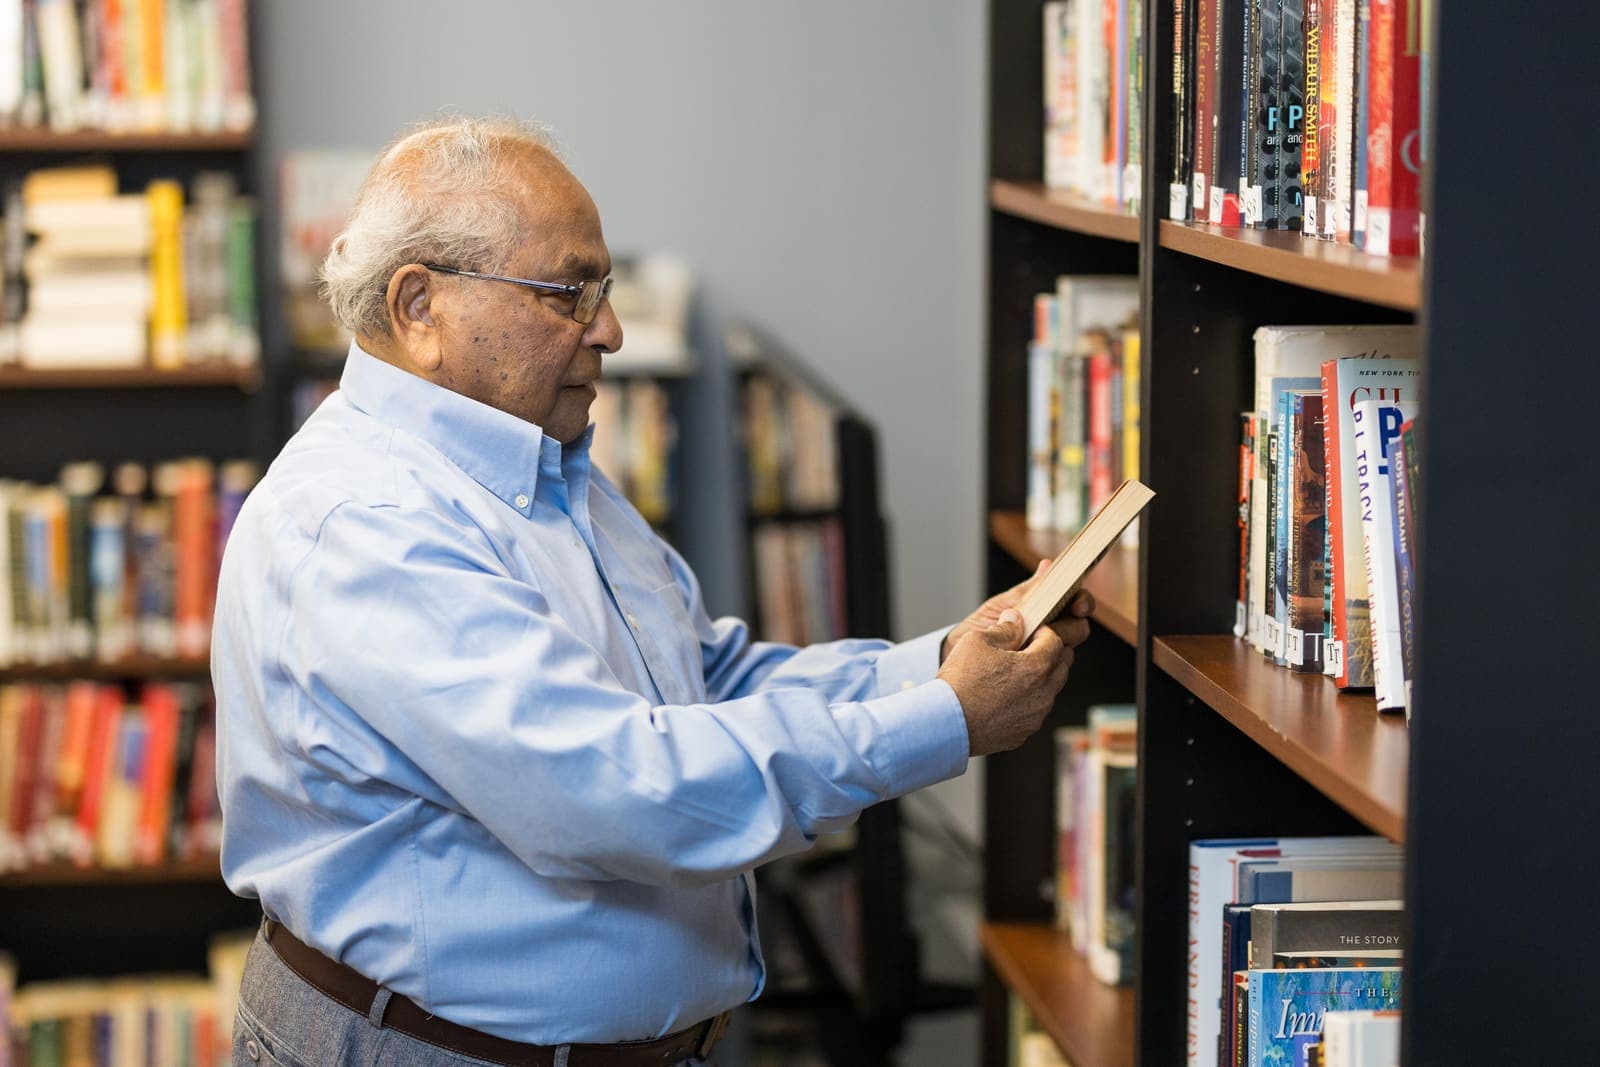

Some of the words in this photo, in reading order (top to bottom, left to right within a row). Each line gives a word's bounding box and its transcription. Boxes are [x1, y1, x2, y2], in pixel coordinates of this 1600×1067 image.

[1306, 26, 1319, 104] WILBUR
[1305, 104, 1318, 161] SMITH
[1277, 413, 1286, 482] SHOOTING
[1356, 450, 1372, 522] TRACY
[1394, 451, 1406, 486] ROSE
[1277, 487, 1285, 519] STAR
[1396, 489, 1408, 553] TREMAIN
[1327, 643, 1334, 661] T
[1334, 648, 1340, 664] T
[1340, 935, 1360, 945] THE
[1364, 935, 1400, 945] STORY
[1354, 988, 1390, 997] THE
